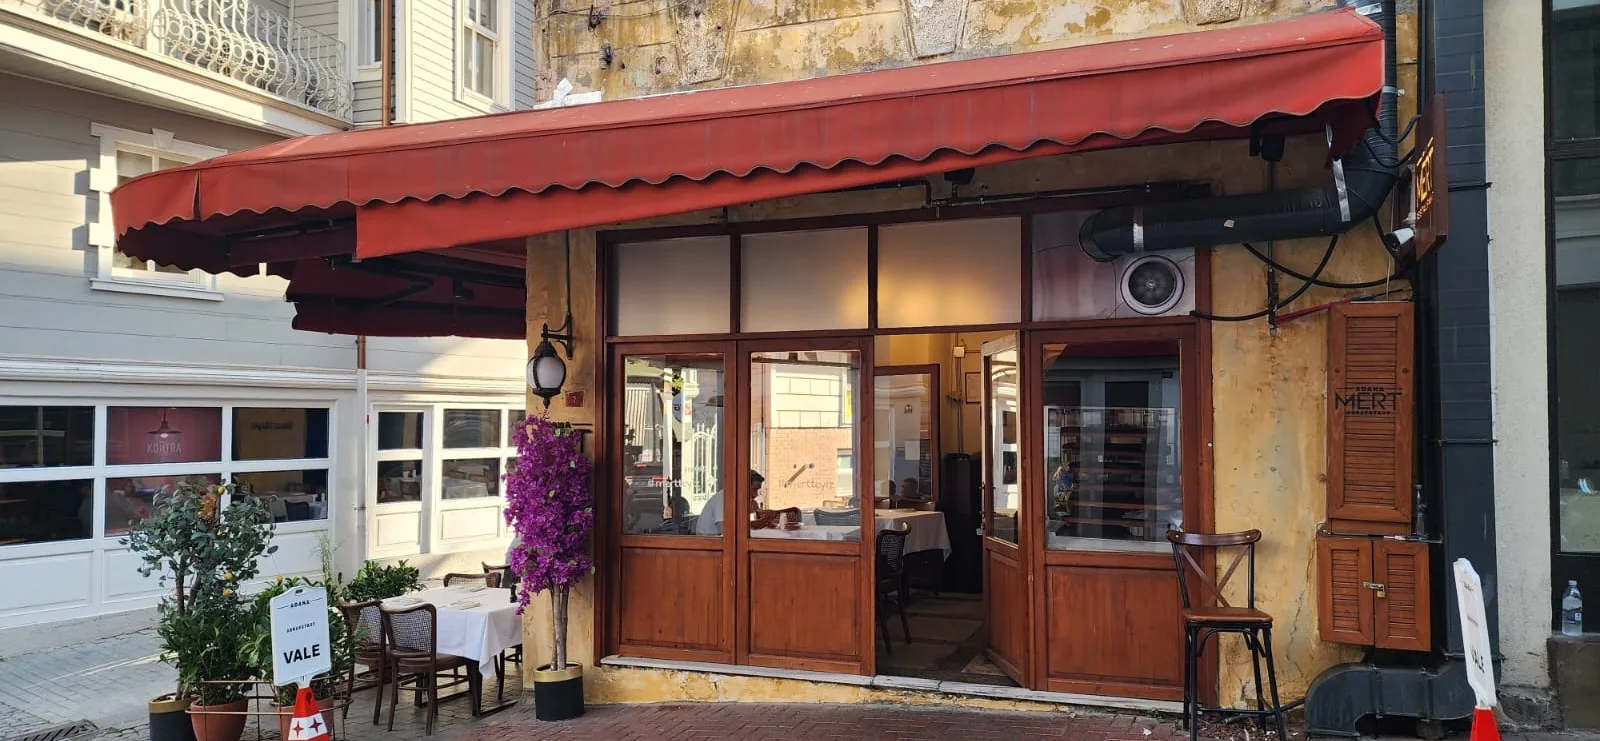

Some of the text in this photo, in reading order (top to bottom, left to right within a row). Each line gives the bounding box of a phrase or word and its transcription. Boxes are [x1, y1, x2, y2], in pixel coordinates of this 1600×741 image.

[1335, 392, 1402, 409] MERT
[291, 600, 310, 608] ADANA
[283, 644, 320, 664] VALE
